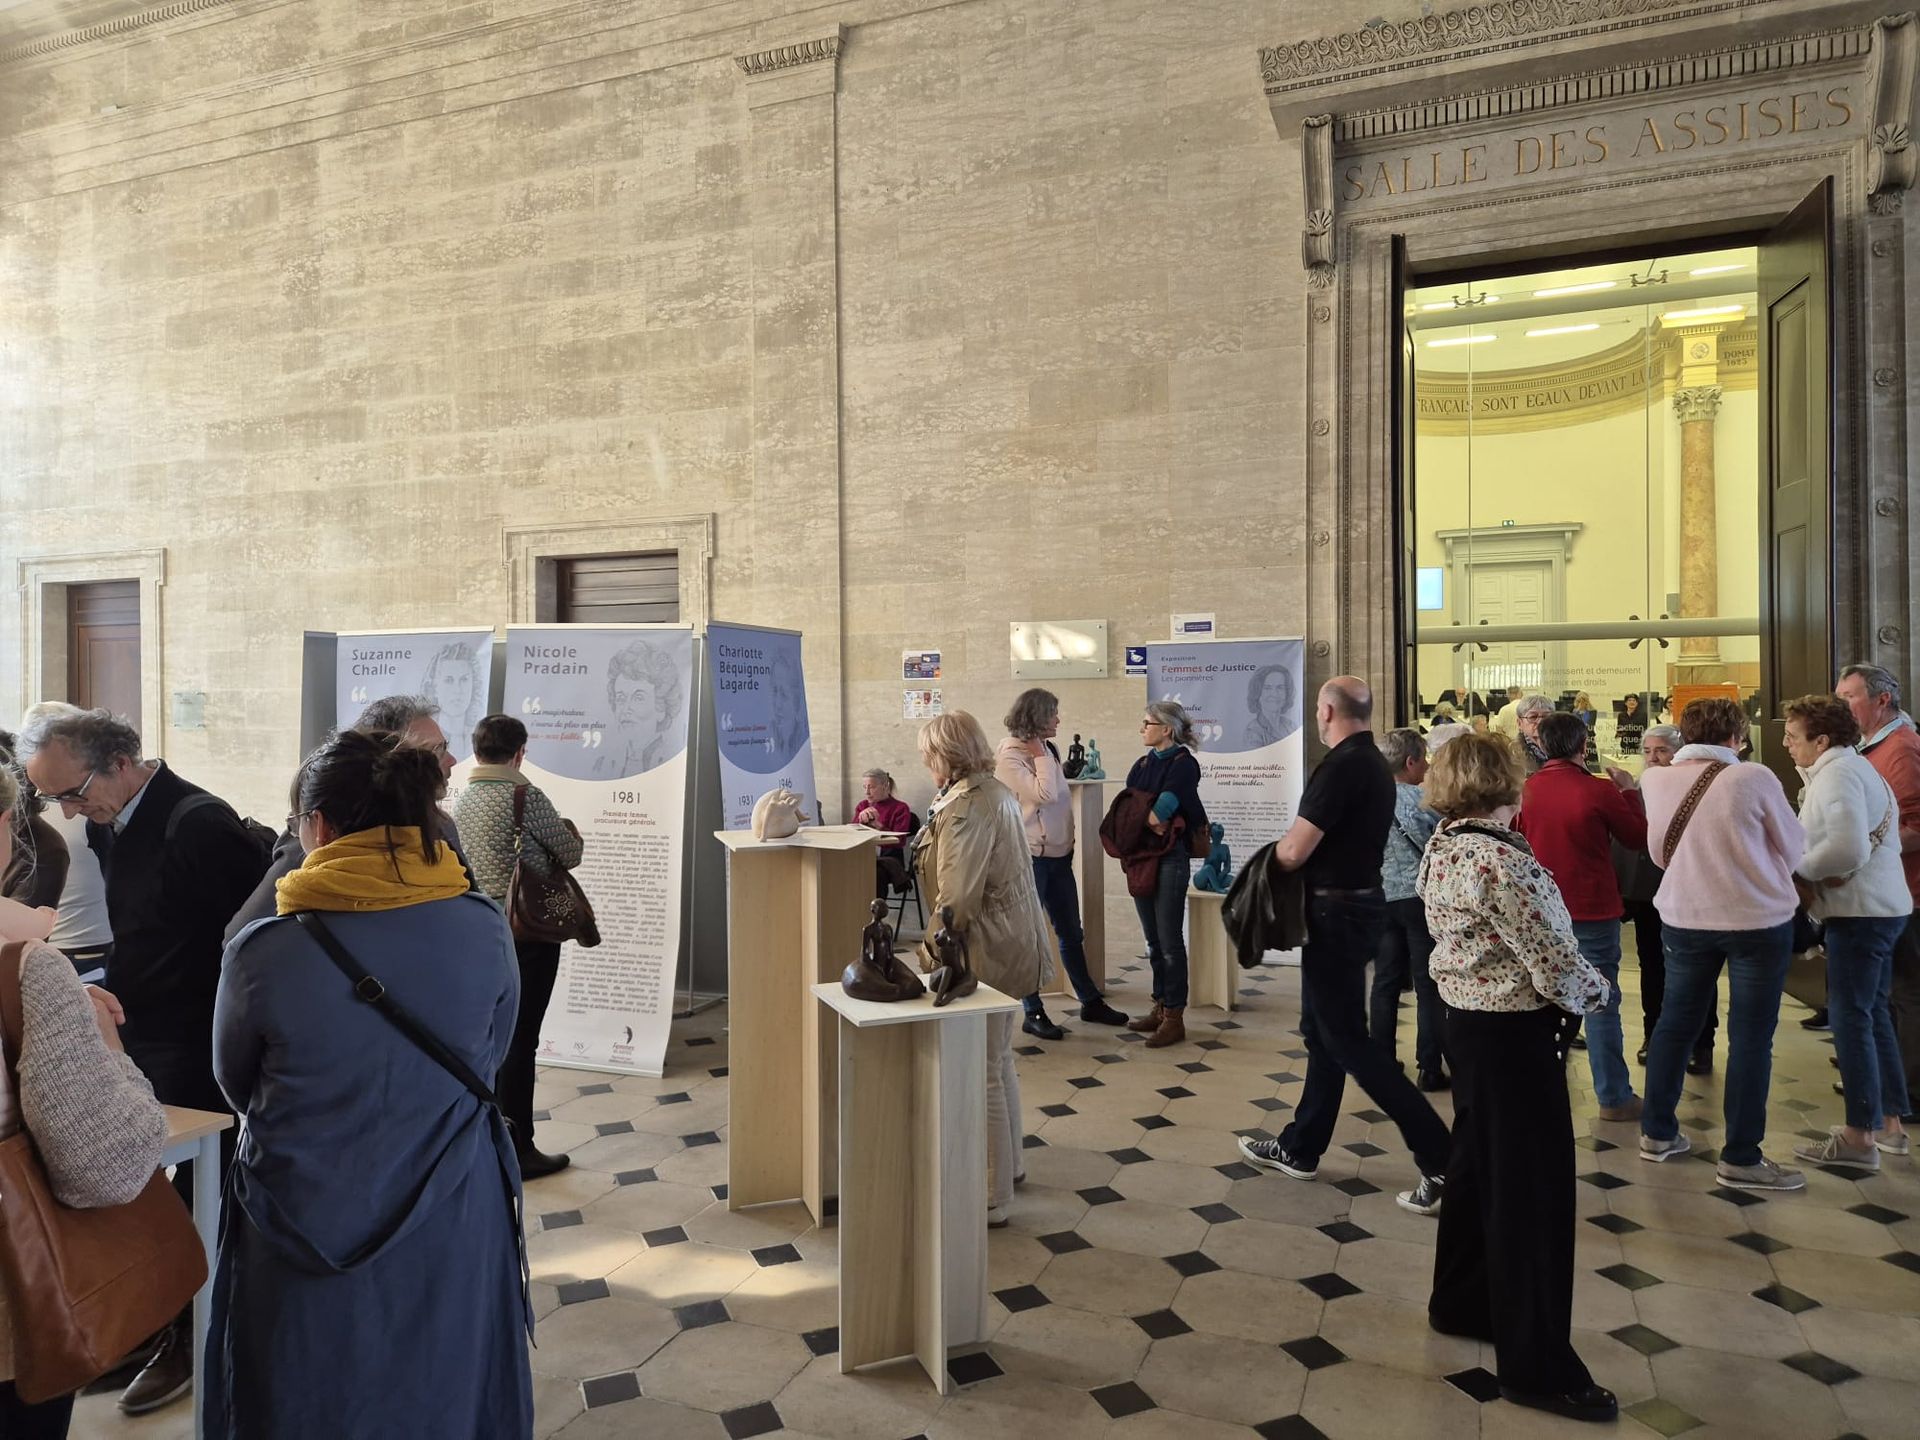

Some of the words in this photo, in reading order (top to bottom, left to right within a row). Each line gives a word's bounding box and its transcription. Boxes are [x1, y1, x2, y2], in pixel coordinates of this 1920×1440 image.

[1343, 145, 1488, 200] SALLE
[1513, 126, 1608, 176] DES
[1631, 86, 1854, 158] ASSISES
[1481, 396, 1519, 412] SONT
[1526, 389, 1571, 408] EGAUX
[1579, 376, 1626, 400] DEVANT
[1632, 371, 1645, 386] LA
[352, 649, 412, 661] Suzanne
[524, 645, 577, 659] Nicole
[719, 645, 763, 659] Charlotte
[352, 663, 396, 676] Challe
[524, 662, 588, 675] Pradain
[720, 661, 770, 678] Béquignon
[1162, 665, 1202, 673] Femmes
[1205, 664, 1218, 672] de
[1220, 663, 1257, 672] Justice
[1595, 666, 1641, 675] demeurent
[720, 678, 760, 693] Lagarde
[1584, 678, 1607, 687] droits
[1210, 763, 1236, 771] femmes
[1215, 771, 1240, 779] femmes
[612, 791, 641, 804] 1981
[738, 795, 753, 806] 1931
